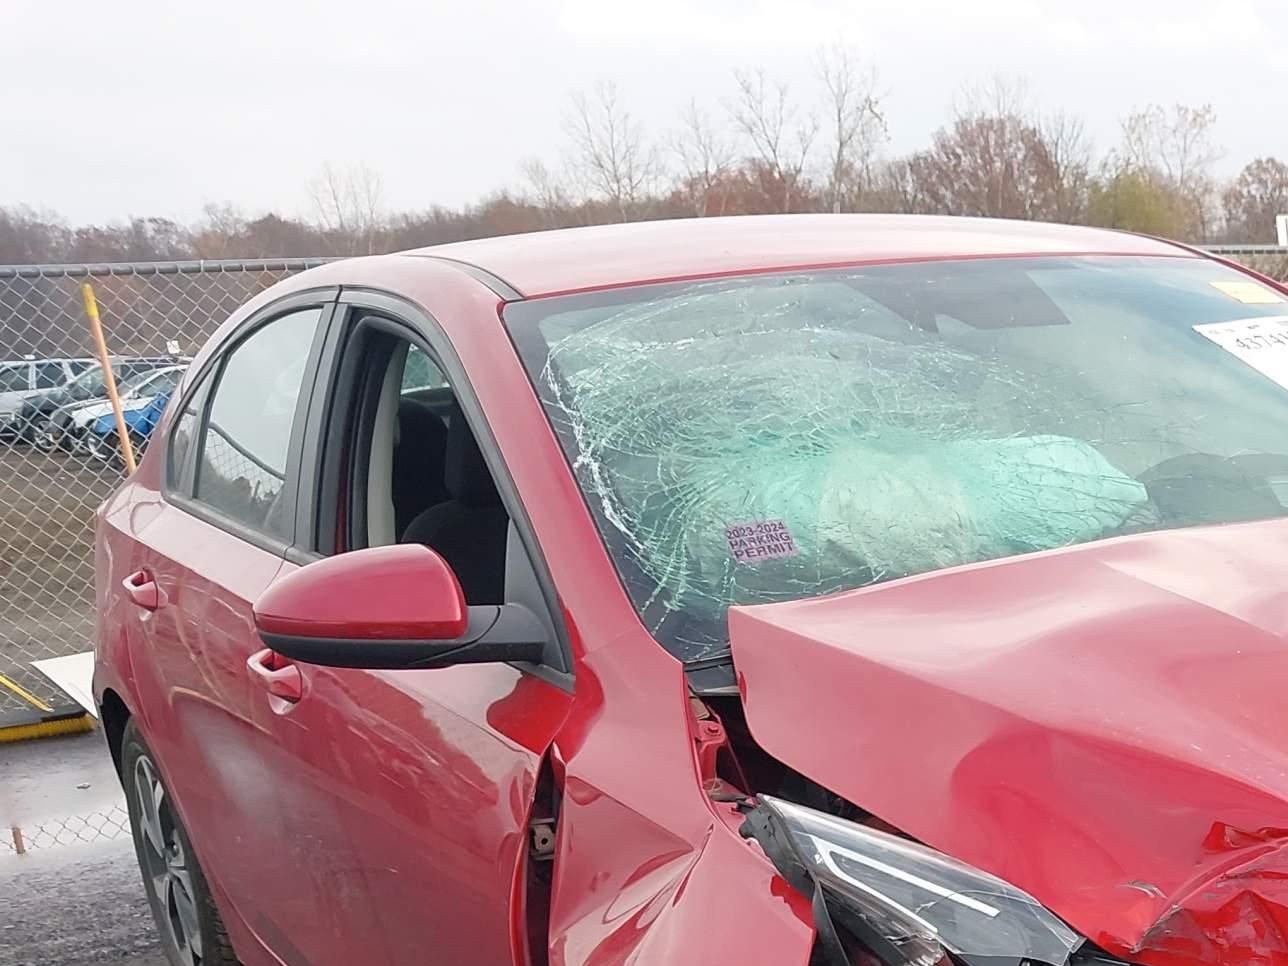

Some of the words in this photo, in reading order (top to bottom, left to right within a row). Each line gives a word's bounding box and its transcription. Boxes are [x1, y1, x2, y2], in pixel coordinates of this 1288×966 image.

[726, 521, 785, 540] 2023-2024
[729, 532, 791, 550] PARKING
[734, 540, 793, 559] PERMIT
